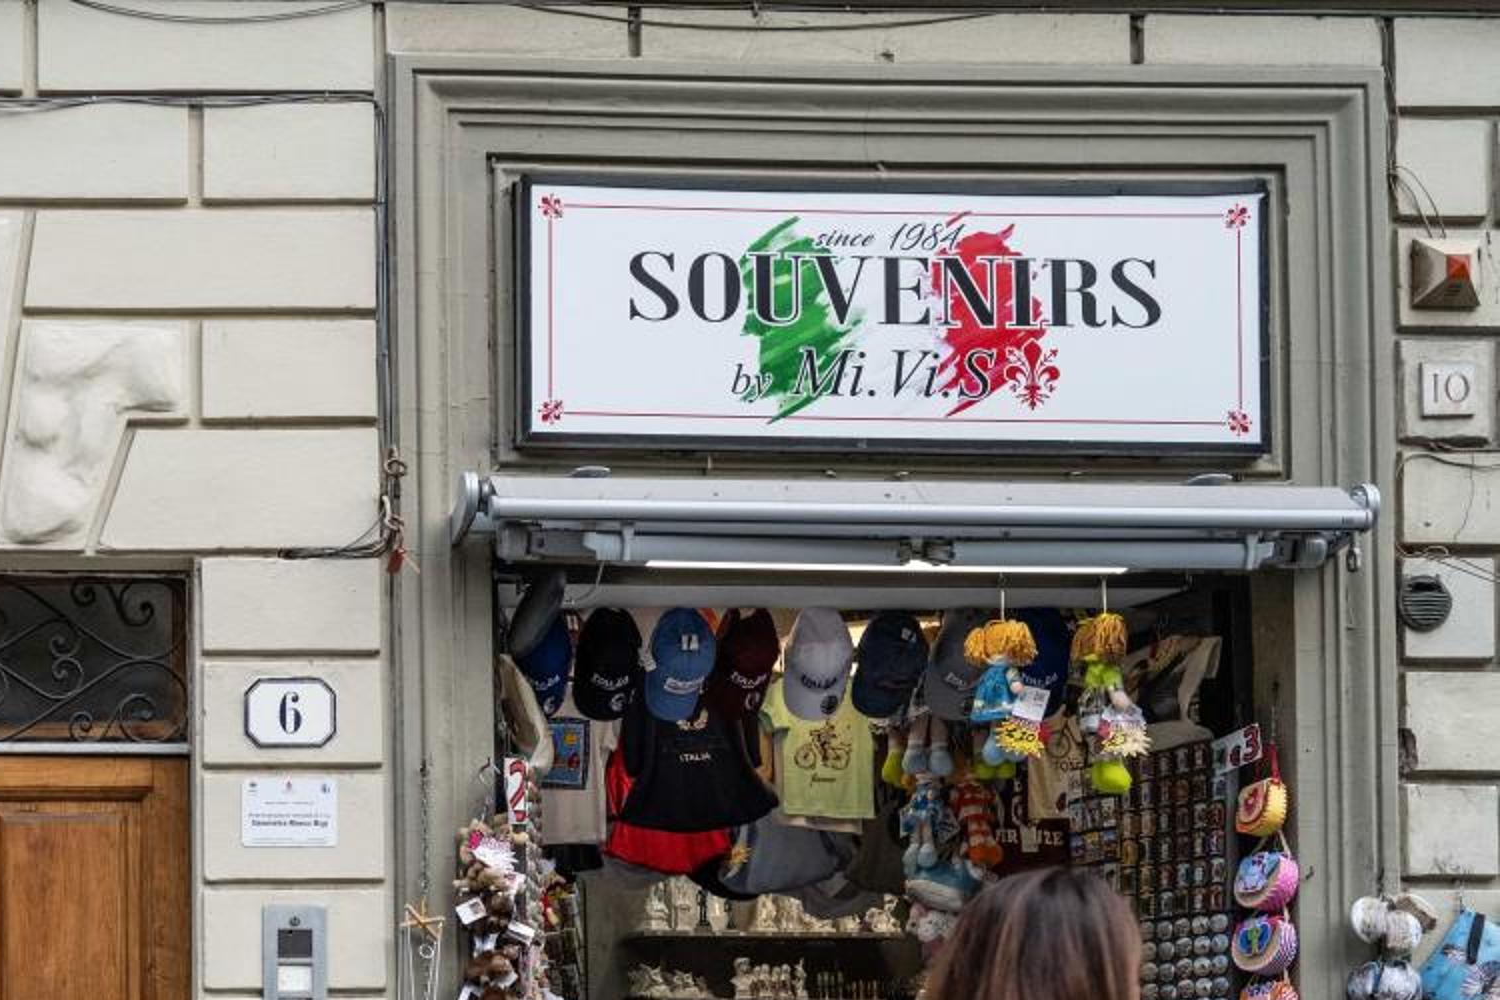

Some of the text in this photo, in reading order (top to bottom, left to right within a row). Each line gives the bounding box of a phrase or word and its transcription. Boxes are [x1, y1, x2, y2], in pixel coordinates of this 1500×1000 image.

[813, 221, 965, 252] since 1984
[629, 250, 1162, 330] SOUVENIRS
[731, 363, 773, 403] by
[1432, 370, 1471, 404] 10
[278, 690, 303, 735] 6
